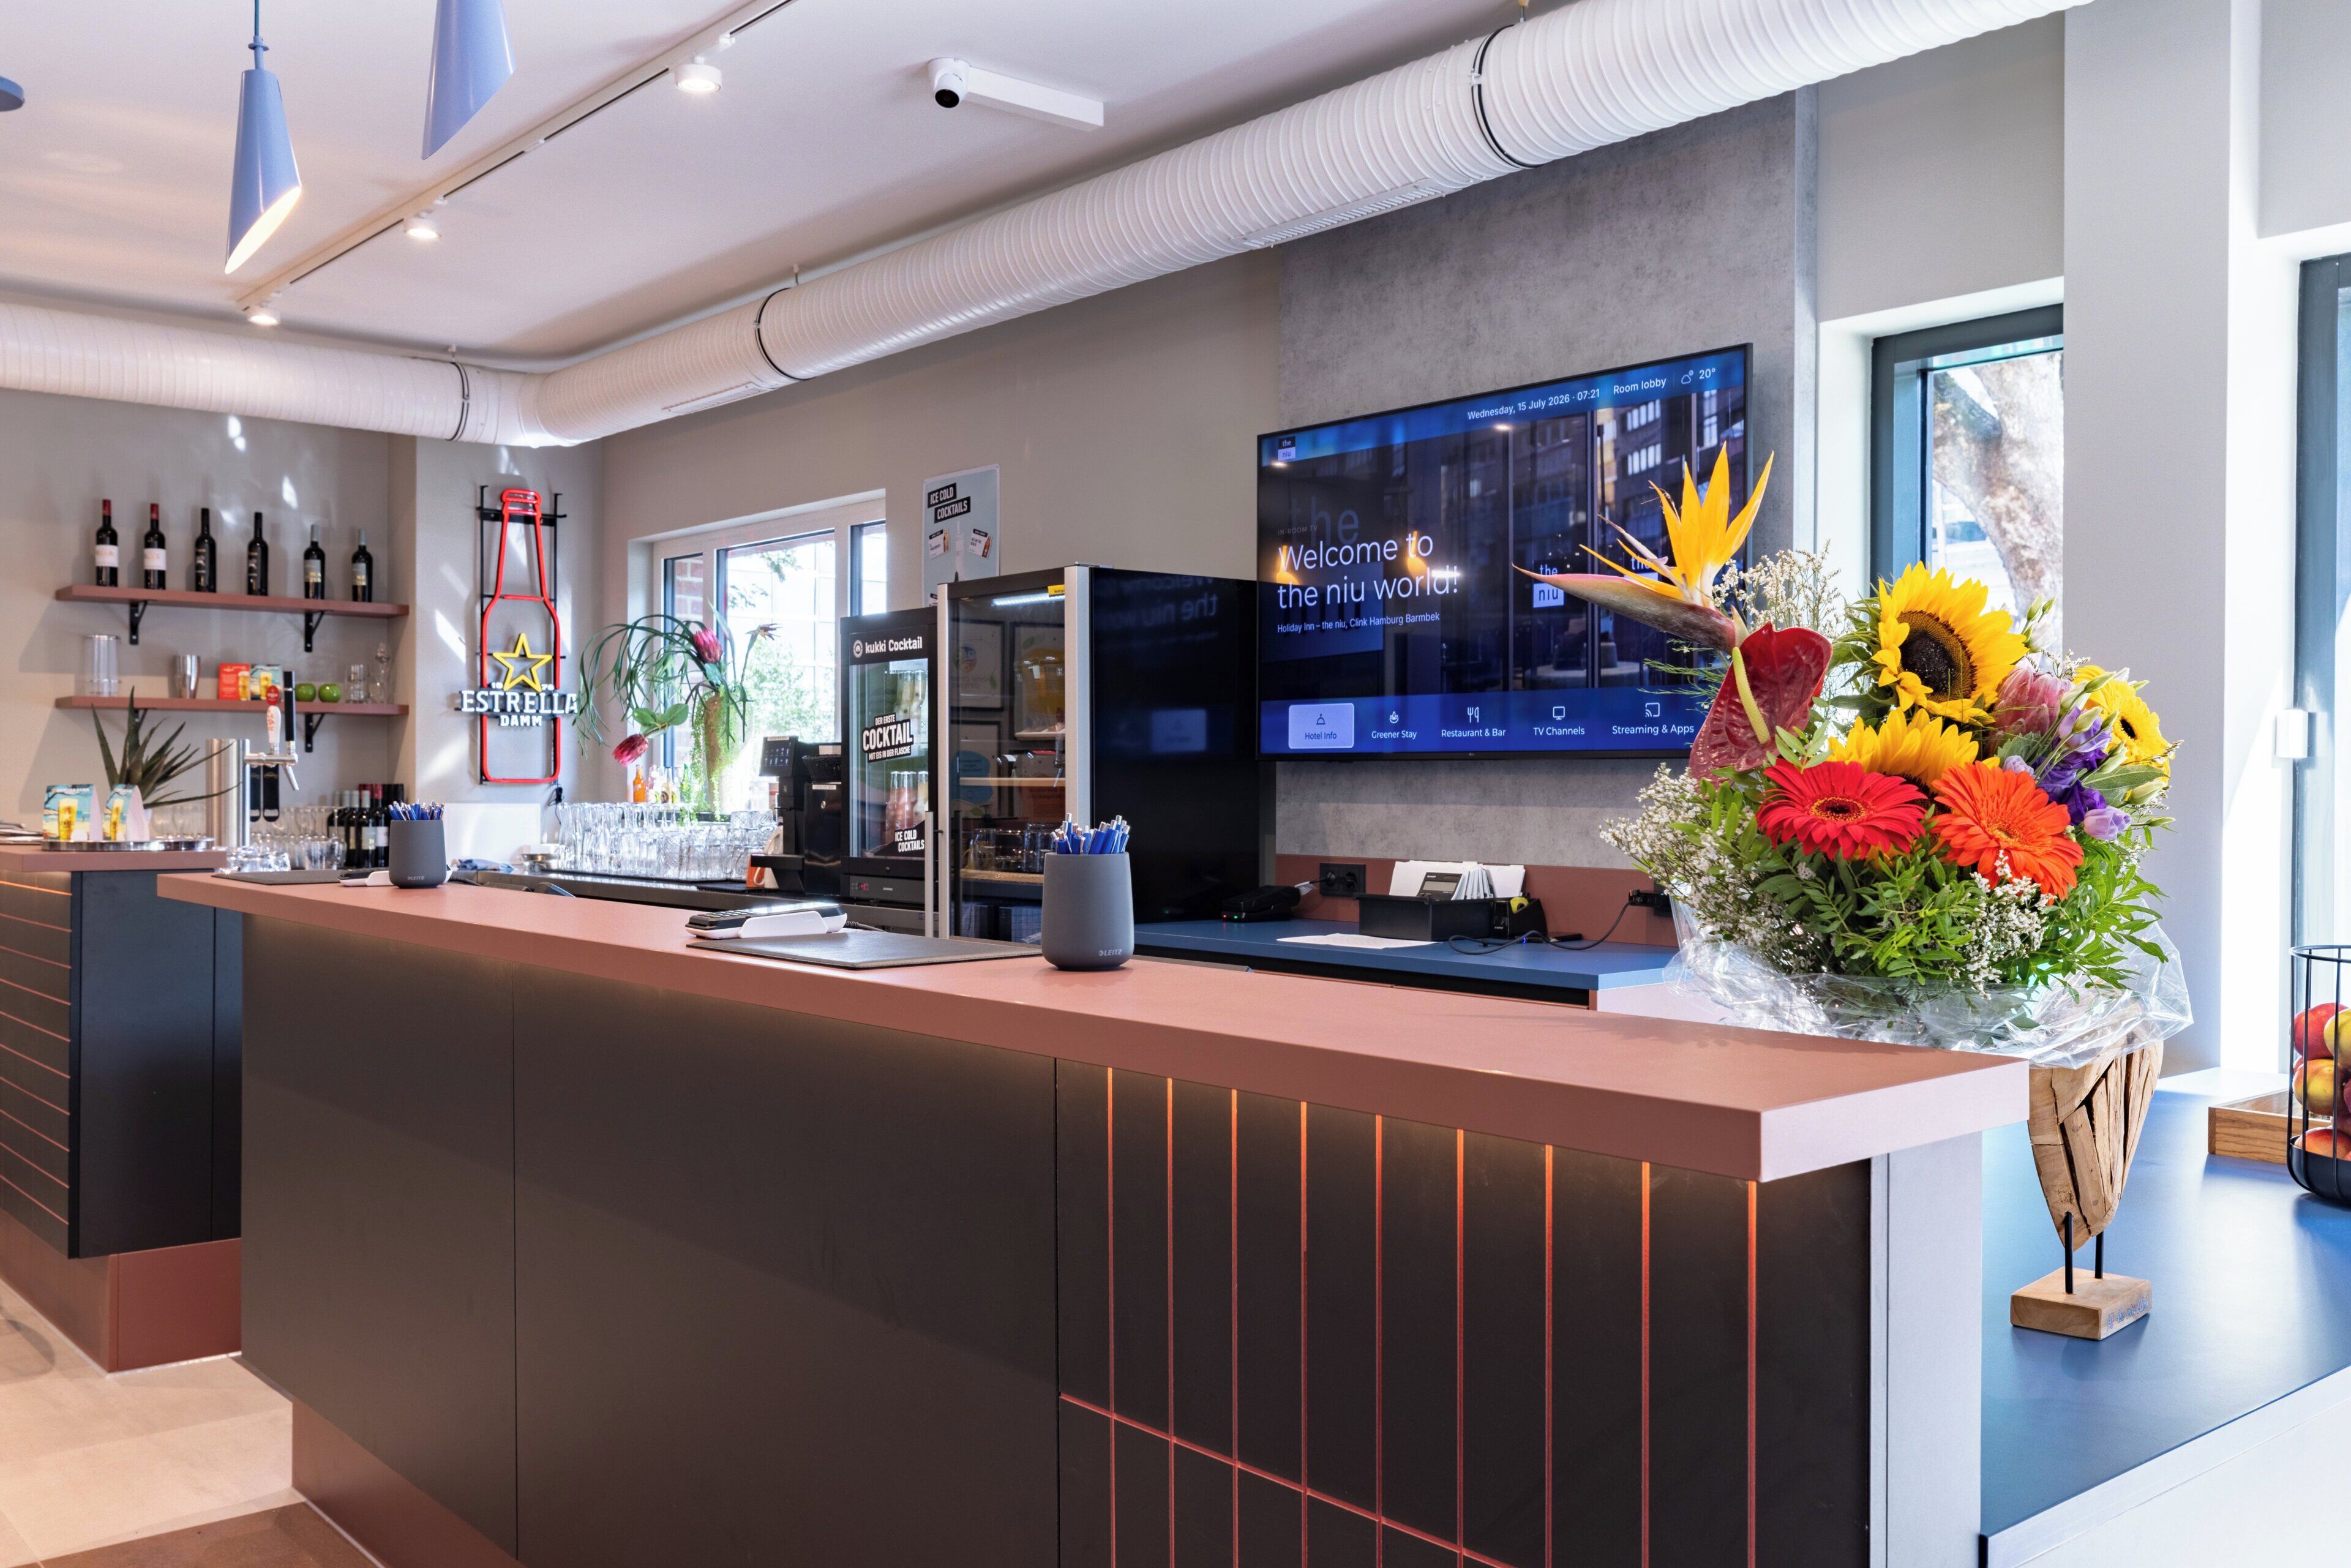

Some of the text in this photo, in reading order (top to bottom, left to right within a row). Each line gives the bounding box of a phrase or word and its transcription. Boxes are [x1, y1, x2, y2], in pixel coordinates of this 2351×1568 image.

[1699, 367, 1716, 380] 20°
[1613, 378, 1667, 395] Room lobby
[1468, 405, 1515, 420] Wednesday,
[1518, 402, 1526, 411] 15
[1529, 399, 1545, 411] July
[1548, 394, 1570, 406] 2026
[1577, 388, 1600, 400] 07:21
[930, 487, 954, 505] ICE COLD
[937, 500, 967, 520] COCKTAILS
[1279, 533, 1433, 571] Welcome to
[1631, 555, 1650, 570] th
[1540, 564, 1558, 576] the
[1278, 565, 1458, 609] the niu world!
[1539, 589, 1559, 601] niu
[1278, 623, 1302, 633] Holiday
[1304, 622, 1314, 631] Inn
[1322, 620, 1332, 629] the
[1335, 620, 1348, 631] niu,
[1350, 617, 1367, 627] Clink
[1370, 615, 1403, 626] Hamburg
[1406, 612, 1440, 622] Barmbek
[865, 636, 923, 654] kukki Cocktail
[461, 690, 579, 714] ESTRELLA
[500, 715, 542, 727] DAMM
[883, 714, 896, 724] ERSTE
[863, 722, 913, 751] COCKTAIL
[1401, 730, 1417, 740] Stay
[1546, 726, 1585, 735] Channels
[1612, 724, 1659, 735] Streaming
[1670, 724, 1694, 735] Apps
[894, 746, 910, 756] FLASCHE
[894, 830, 917, 842] ICE COLD
[898, 839, 924, 852] COCKTAILS
